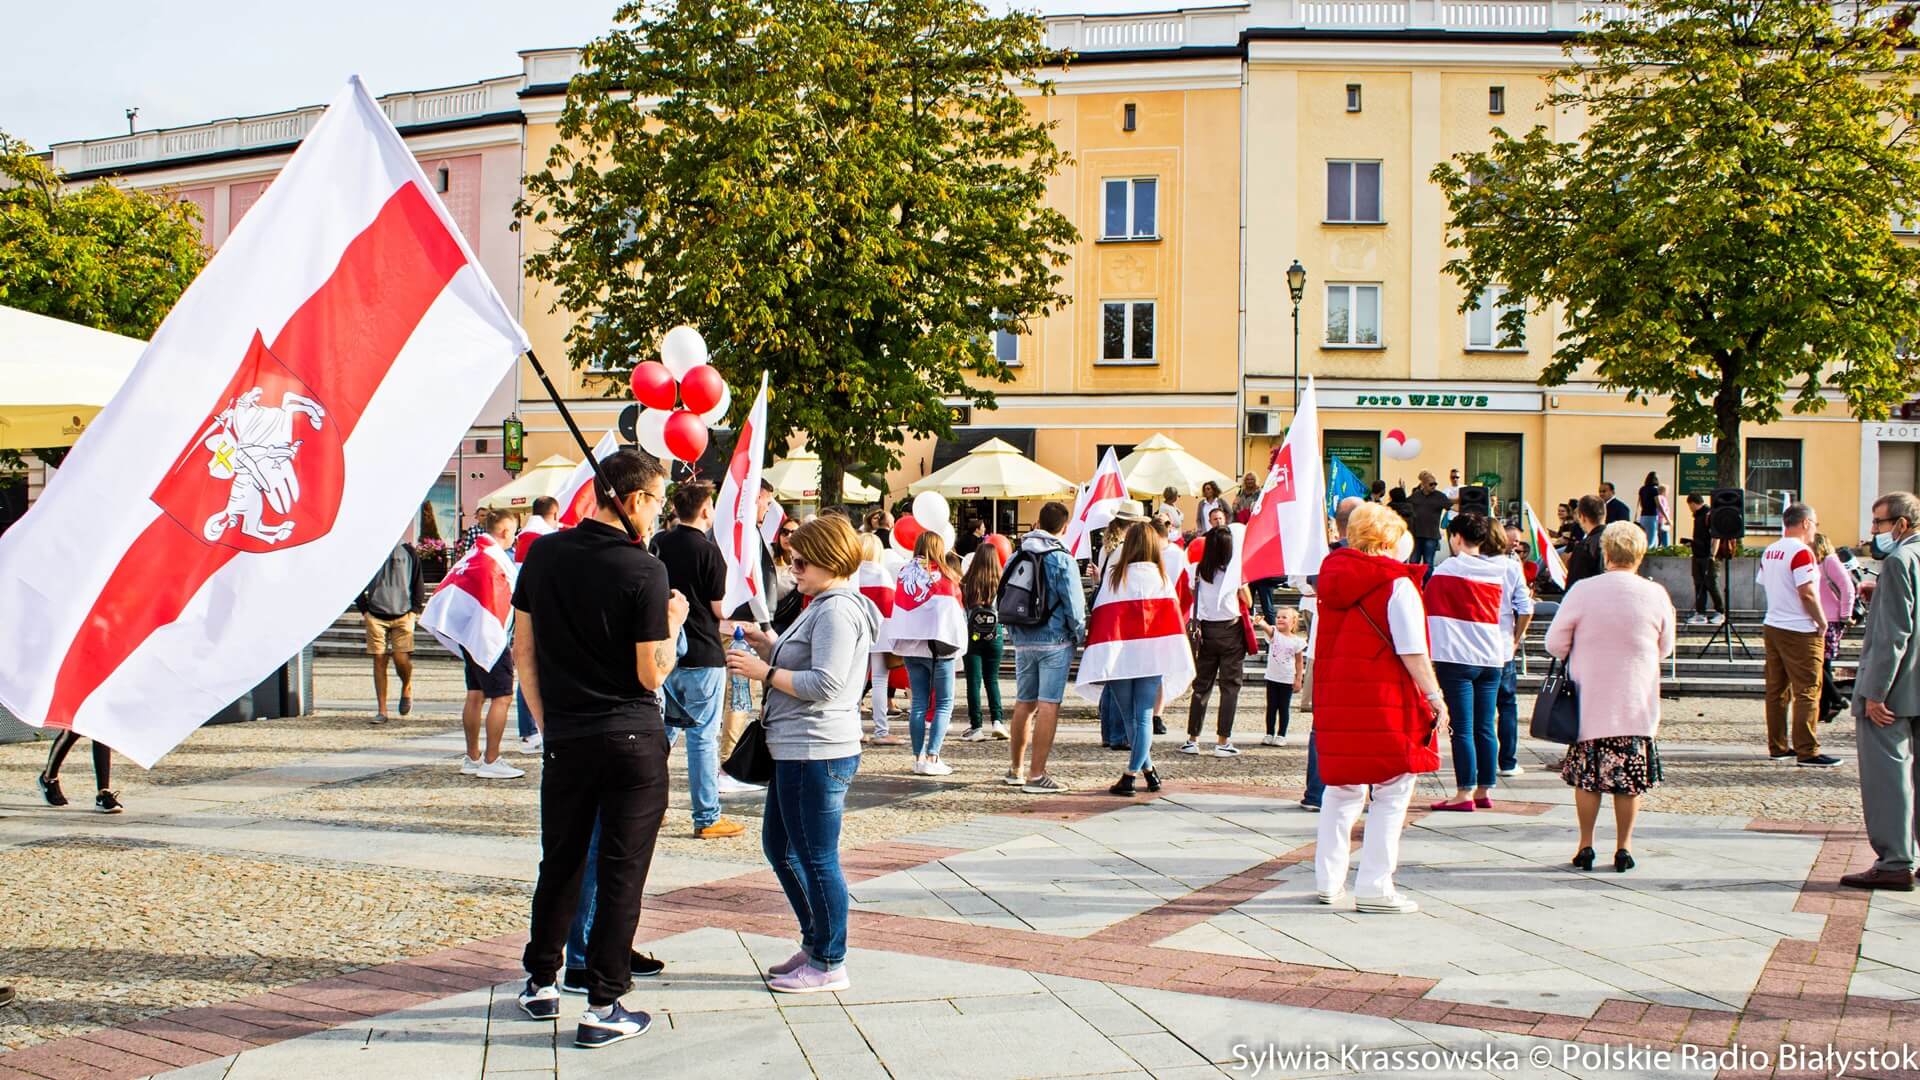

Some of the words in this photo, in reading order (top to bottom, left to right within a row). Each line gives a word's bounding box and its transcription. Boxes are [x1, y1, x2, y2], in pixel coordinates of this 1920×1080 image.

[1357, 395, 1402, 406] FOTO
[1408, 394, 1489, 407] WENUS
[1701, 432, 1711, 444] 13
